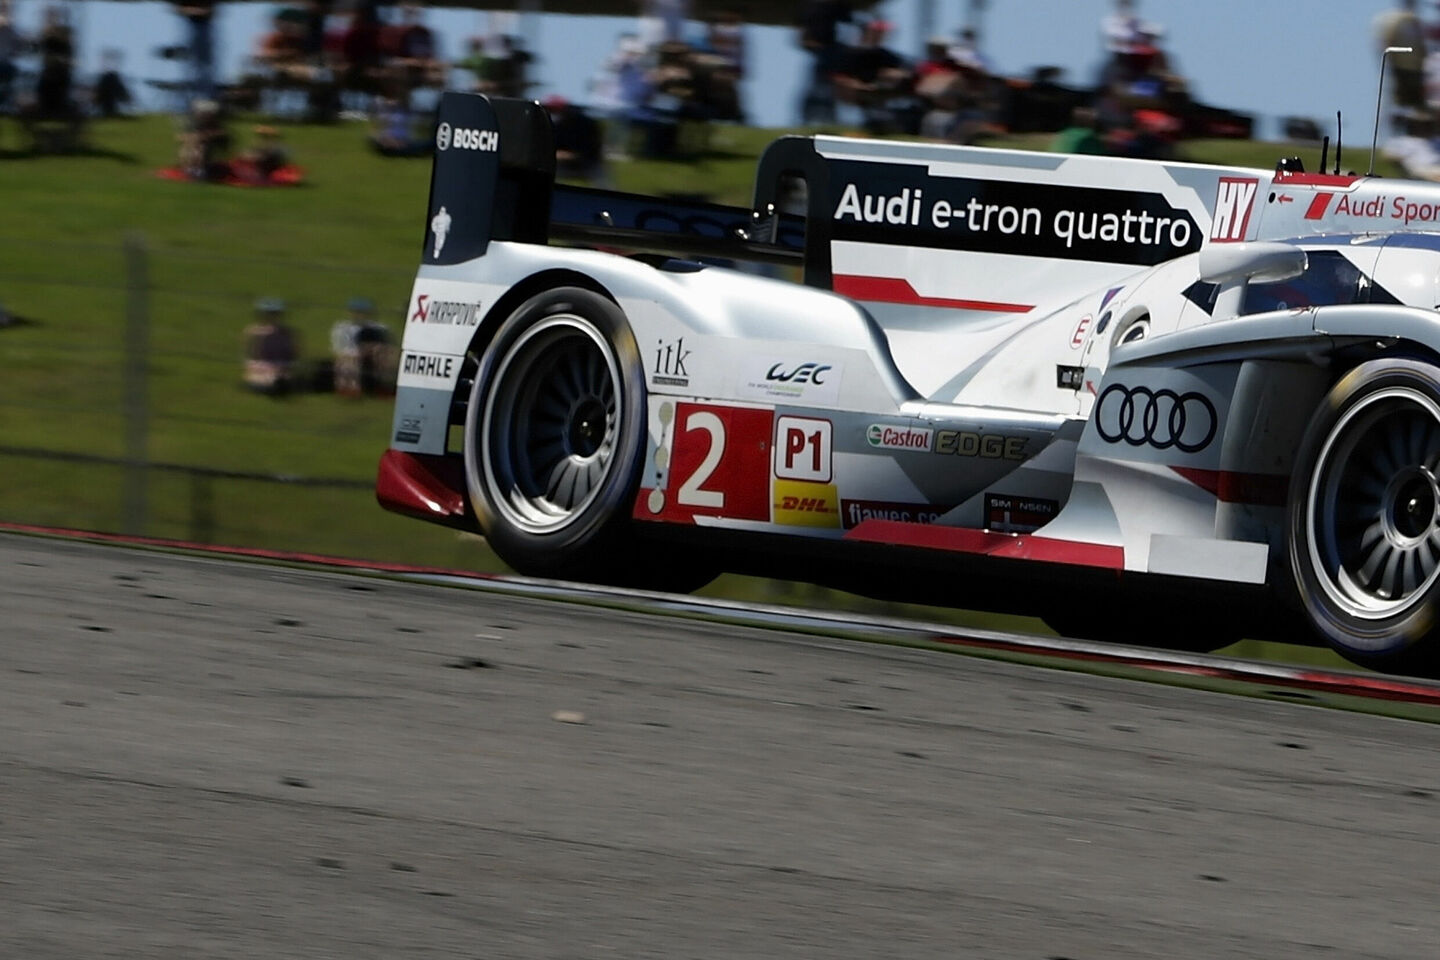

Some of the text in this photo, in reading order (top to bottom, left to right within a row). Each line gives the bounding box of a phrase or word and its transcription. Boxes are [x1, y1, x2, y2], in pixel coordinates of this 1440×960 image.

[453, 127, 499, 152] BOSCH
[834, 183, 1192, 248] Audi e-tron quattro
[1211, 182, 1258, 240] HY
[1335, 194, 1387, 217] Audi
[1072, 319, 1090, 344] E
[403, 355, 453, 378] MAHLE
[653, 337, 692, 377] itk
[766, 362, 833, 385] WEC
[785, 427, 823, 472] P1
[882, 427, 1029, 460] Castrol EDGE
[677, 411, 727, 509] 2
[782, 496, 830, 513] DHL
